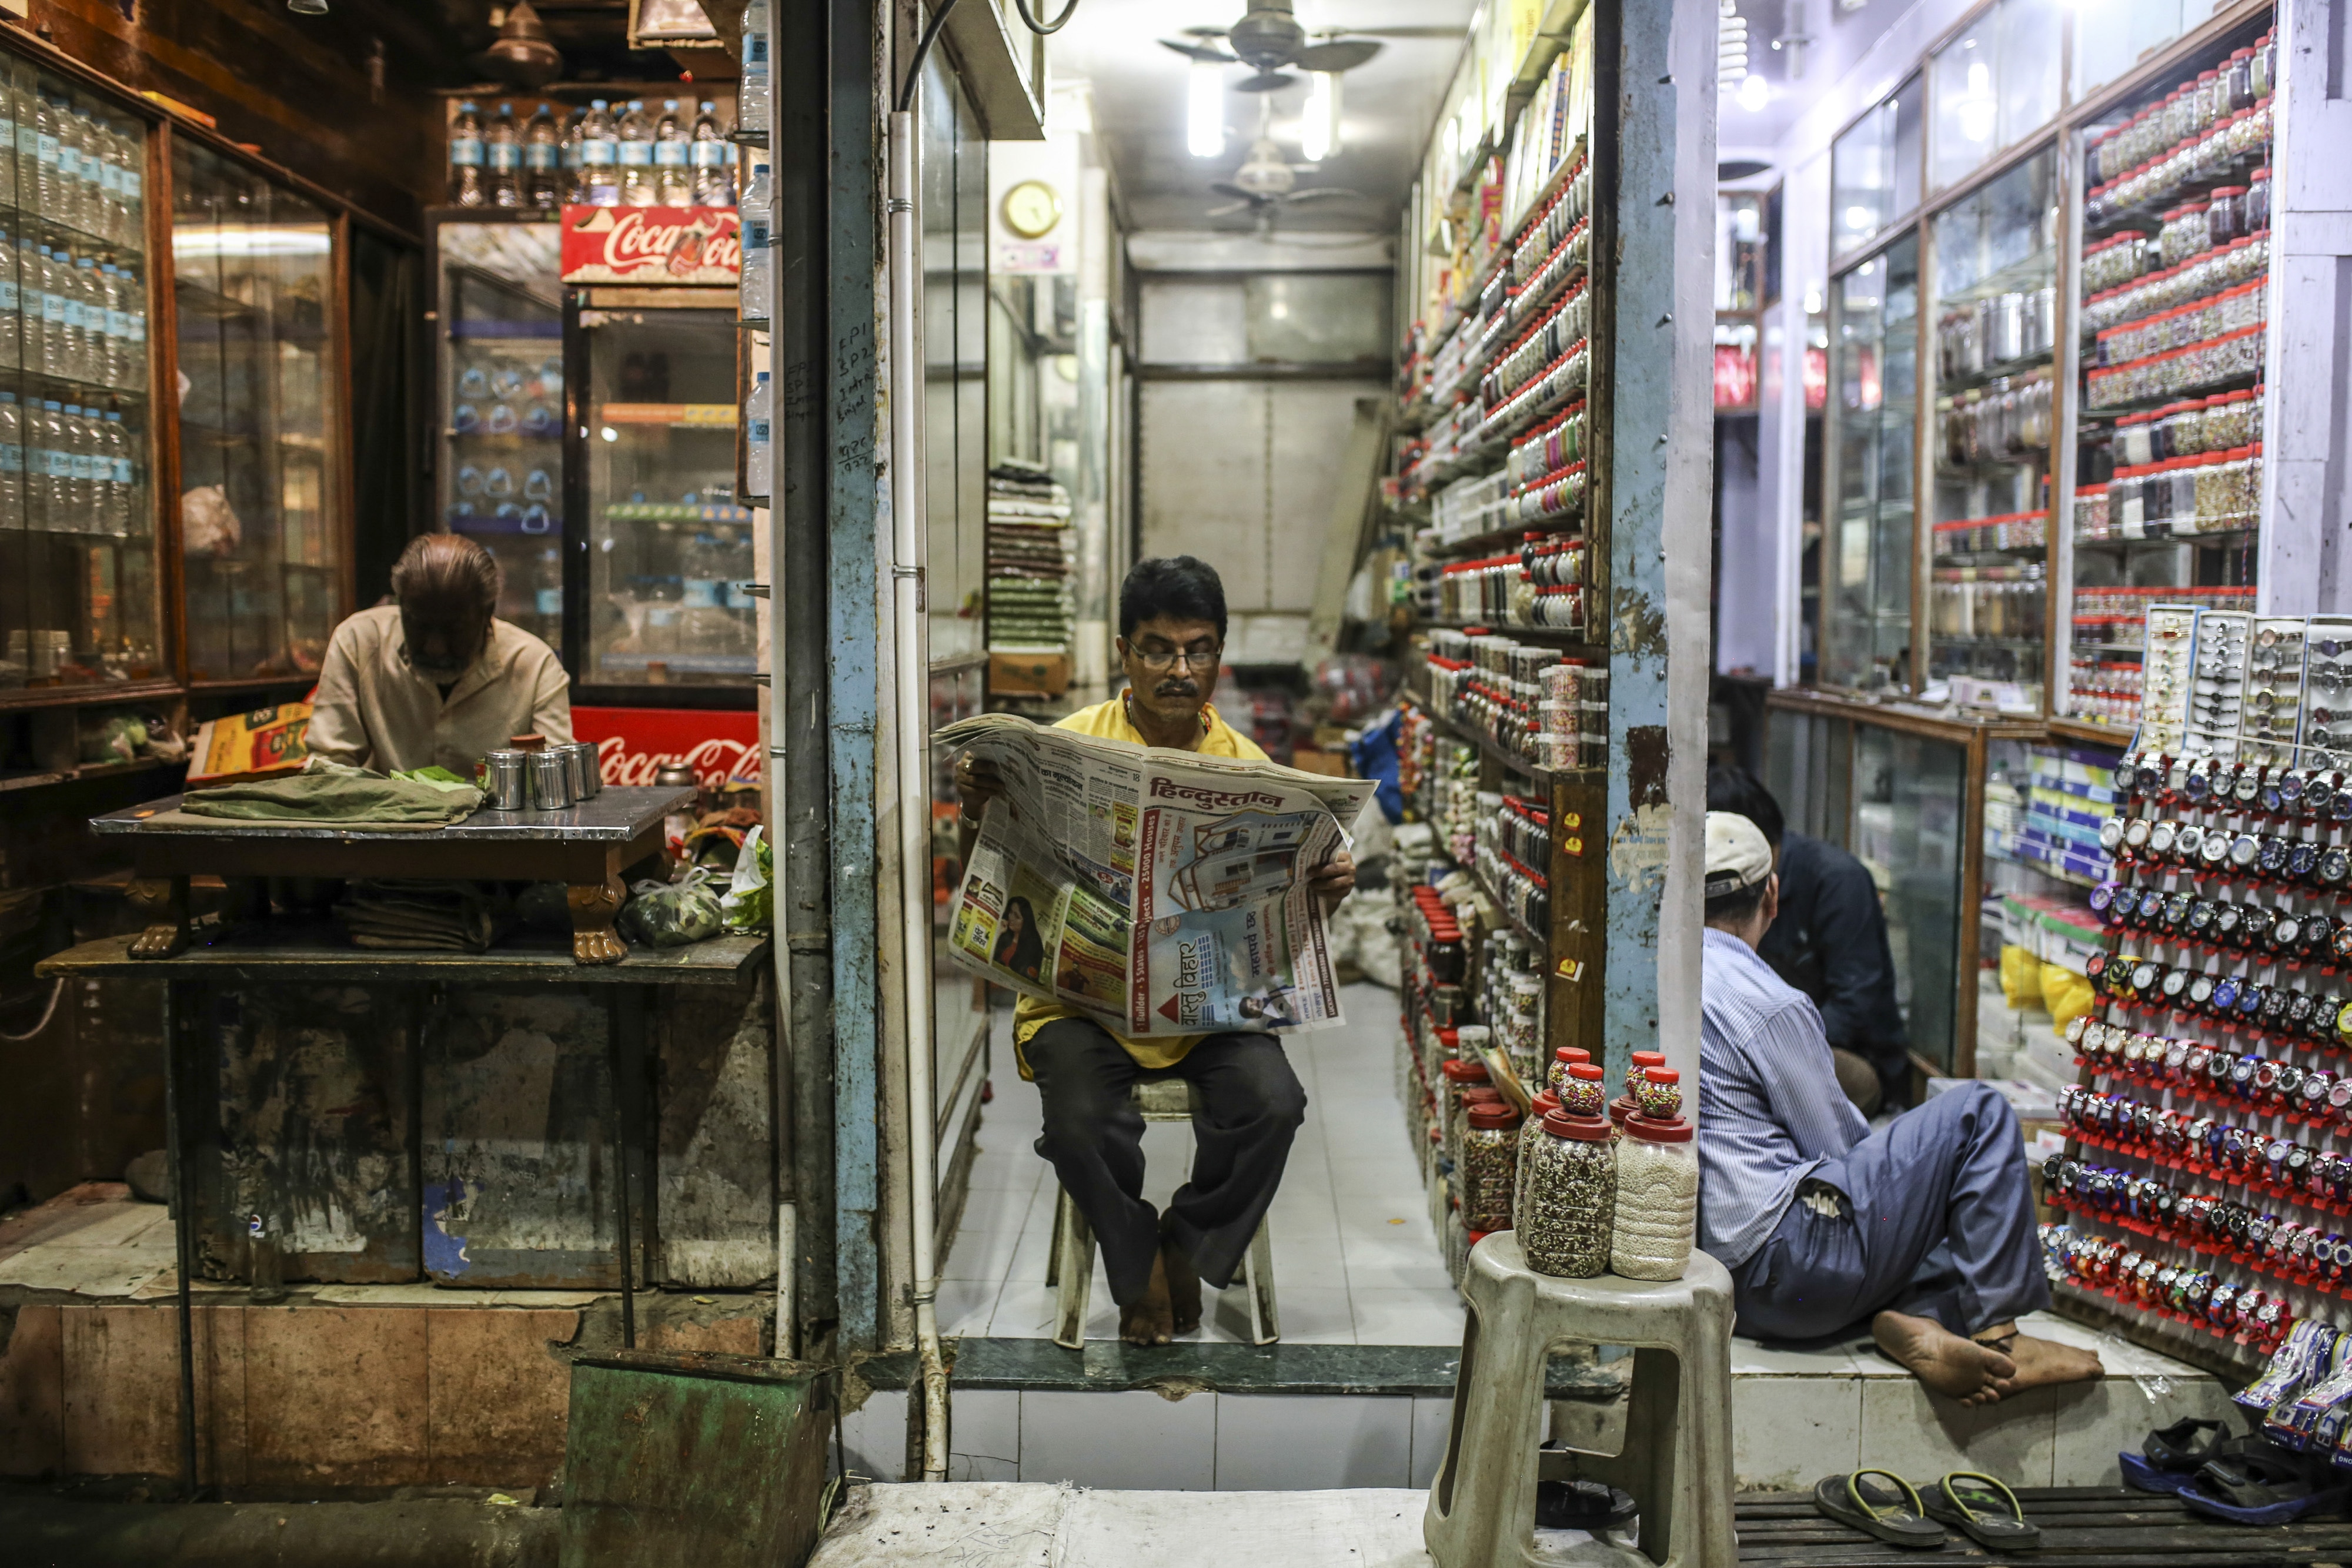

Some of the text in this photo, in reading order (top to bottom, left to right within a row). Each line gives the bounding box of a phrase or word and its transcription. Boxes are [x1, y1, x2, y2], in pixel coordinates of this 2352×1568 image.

[1132, 773, 1140, 783] 18
[1150, 777, 1286, 810] हिन्दुस्तान
[1144, 815, 1155, 850] Houses
[1160, 828, 1171, 848] परिवार
[1170, 835, 1184, 857] अनुपम
[1177, 816, 1187, 833] उपहार
[1142, 853, 1151, 883] 25000
[1137, 950, 1145, 976] States
[1246, 934, 1262, 978] महापर्व
[1173, 941, 1206, 1027] वास्तु विहार
[1137, 992, 1145, 1022] Builder
[1324, 987, 1336, 1015] LUCKNOW
